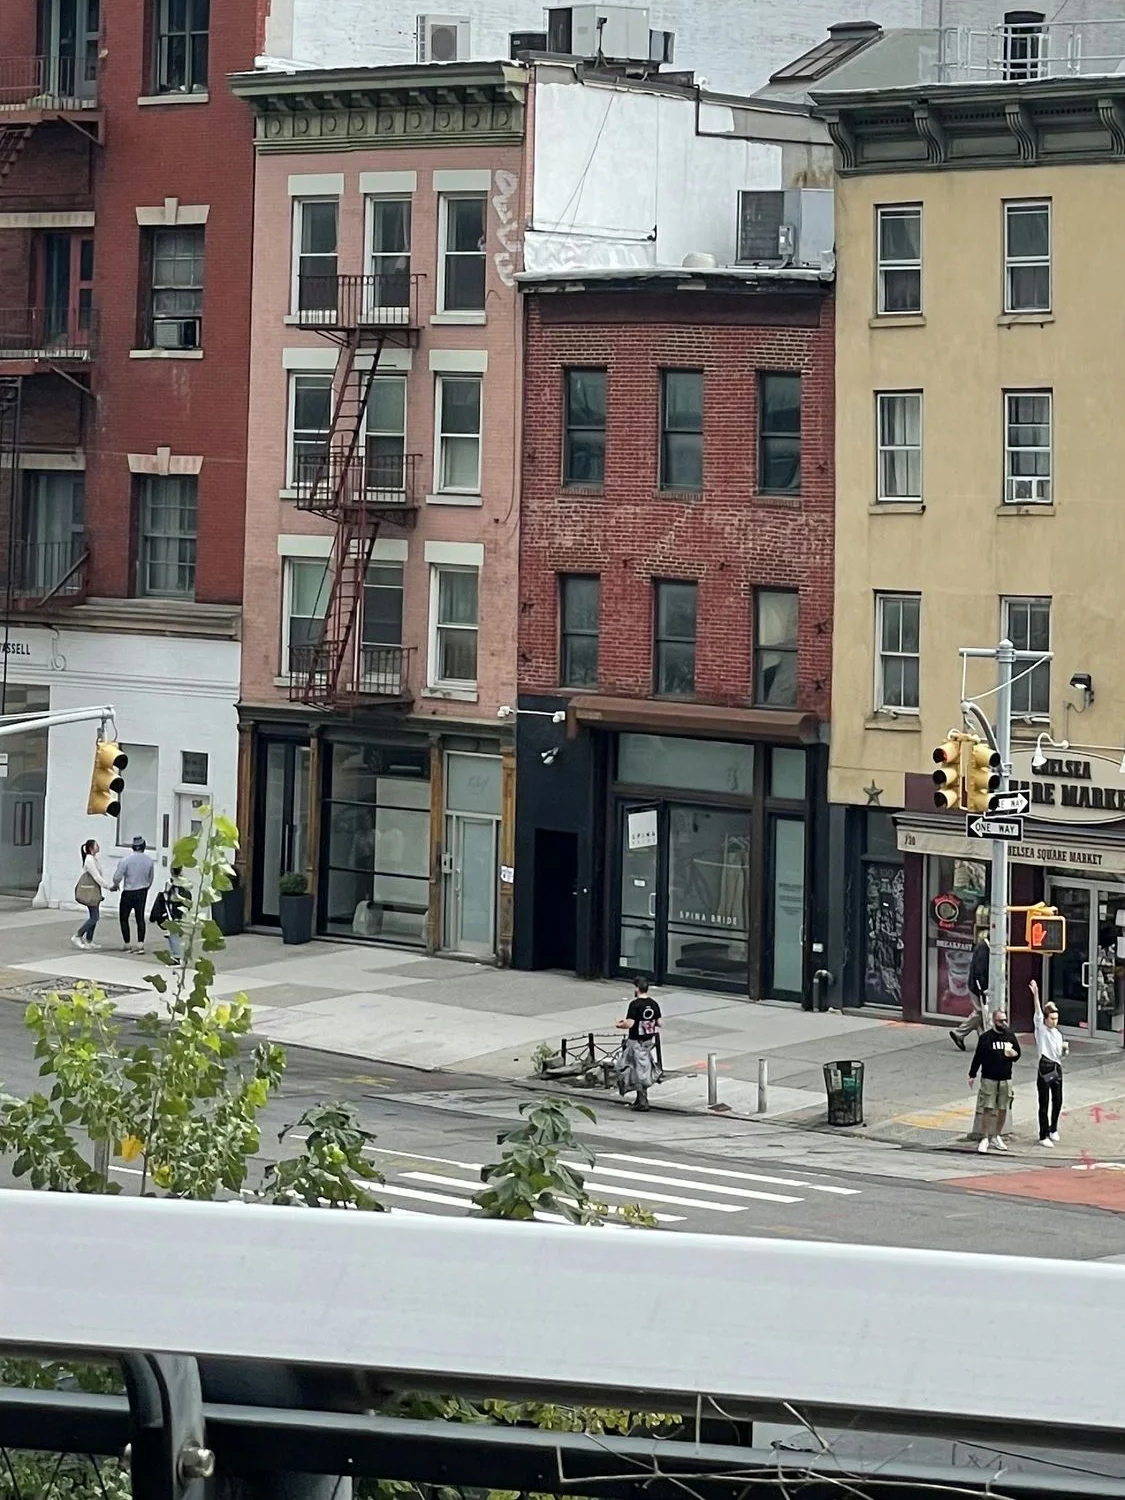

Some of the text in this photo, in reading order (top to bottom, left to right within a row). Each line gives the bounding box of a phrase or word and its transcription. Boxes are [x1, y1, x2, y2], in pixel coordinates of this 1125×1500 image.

[0, 643, 31, 655] ASSELL
[975, 822, 1015, 835] ONE WAY
[1007, 845, 1102, 865] HELSEA SQUARE MARKET
[936, 940, 973, 951] BREAKFAST
